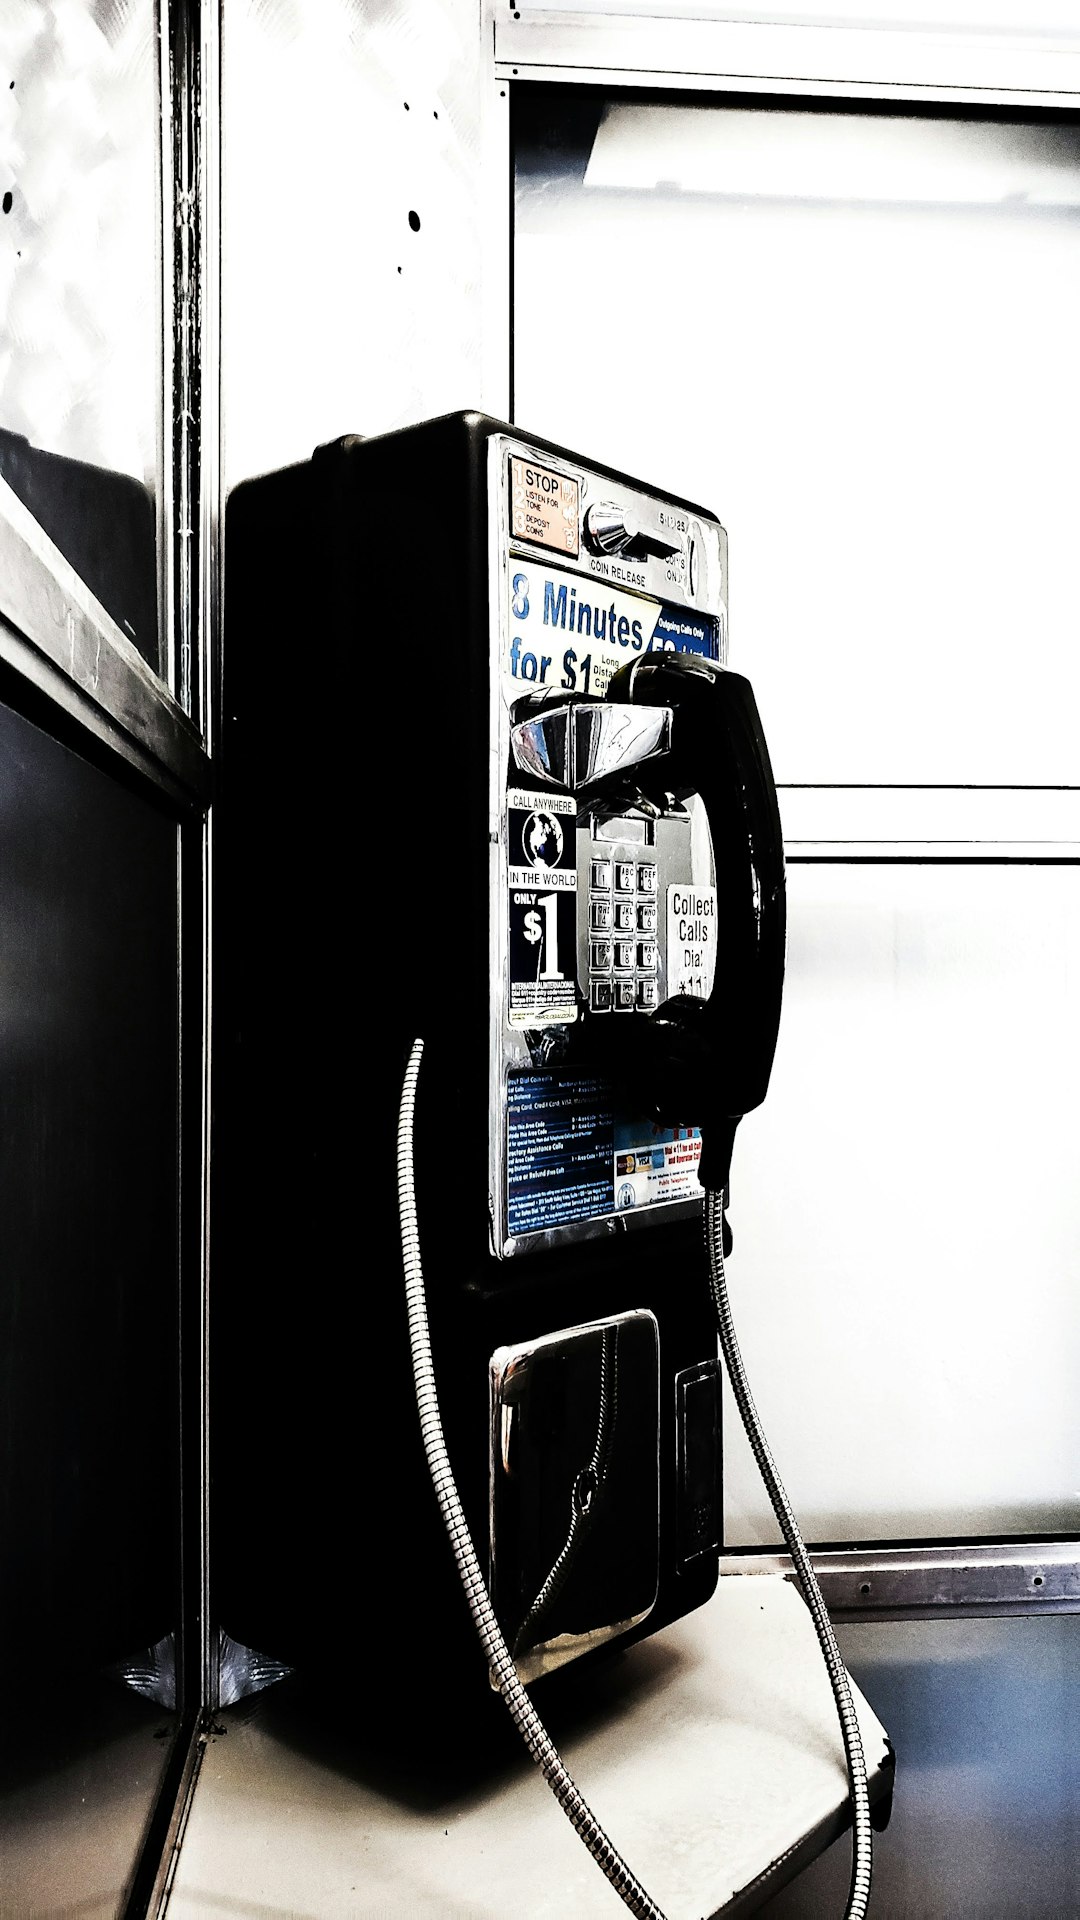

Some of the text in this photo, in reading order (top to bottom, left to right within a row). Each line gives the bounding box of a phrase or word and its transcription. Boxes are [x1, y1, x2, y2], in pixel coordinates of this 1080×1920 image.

[526, 469, 559, 494] STOP
[526, 489, 546, 503] LISTEN
[546, 497, 559, 508] FOR
[526, 514, 550, 529] DEPOSIT
[590, 559, 646, 588] COIN RELEASE
[511, 573, 643, 651] 8 Minutes
[658, 617, 705, 641] Outgoing Calls Only
[510, 636, 593, 695] for $1
[601, 653, 620, 670] Long
[593, 664, 614, 678] Dista
[513, 795, 573, 813] CALL ANYWHERE
[621, 867, 634, 876] ABC
[644, 870, 656, 879] DEF
[509, 871, 577, 886] IN THE WORLD
[601, 874, 605, 884] 1
[624, 876, 630, 887] 2
[647, 879, 653, 889] 3
[513, 893, 537, 905] ONLY
[673, 893, 714, 916] Collect
[622, 905, 633, 915] JKL
[601, 915, 606, 927] 4
[625, 915, 630, 926] 5
[647, 916, 652, 928] 6
[679, 919, 708, 942] Calls
[601, 953, 608, 965] 7
[624, 953, 630, 965] 8
[646, 953, 652, 964] 9
[625, 992, 631, 1003] 0
